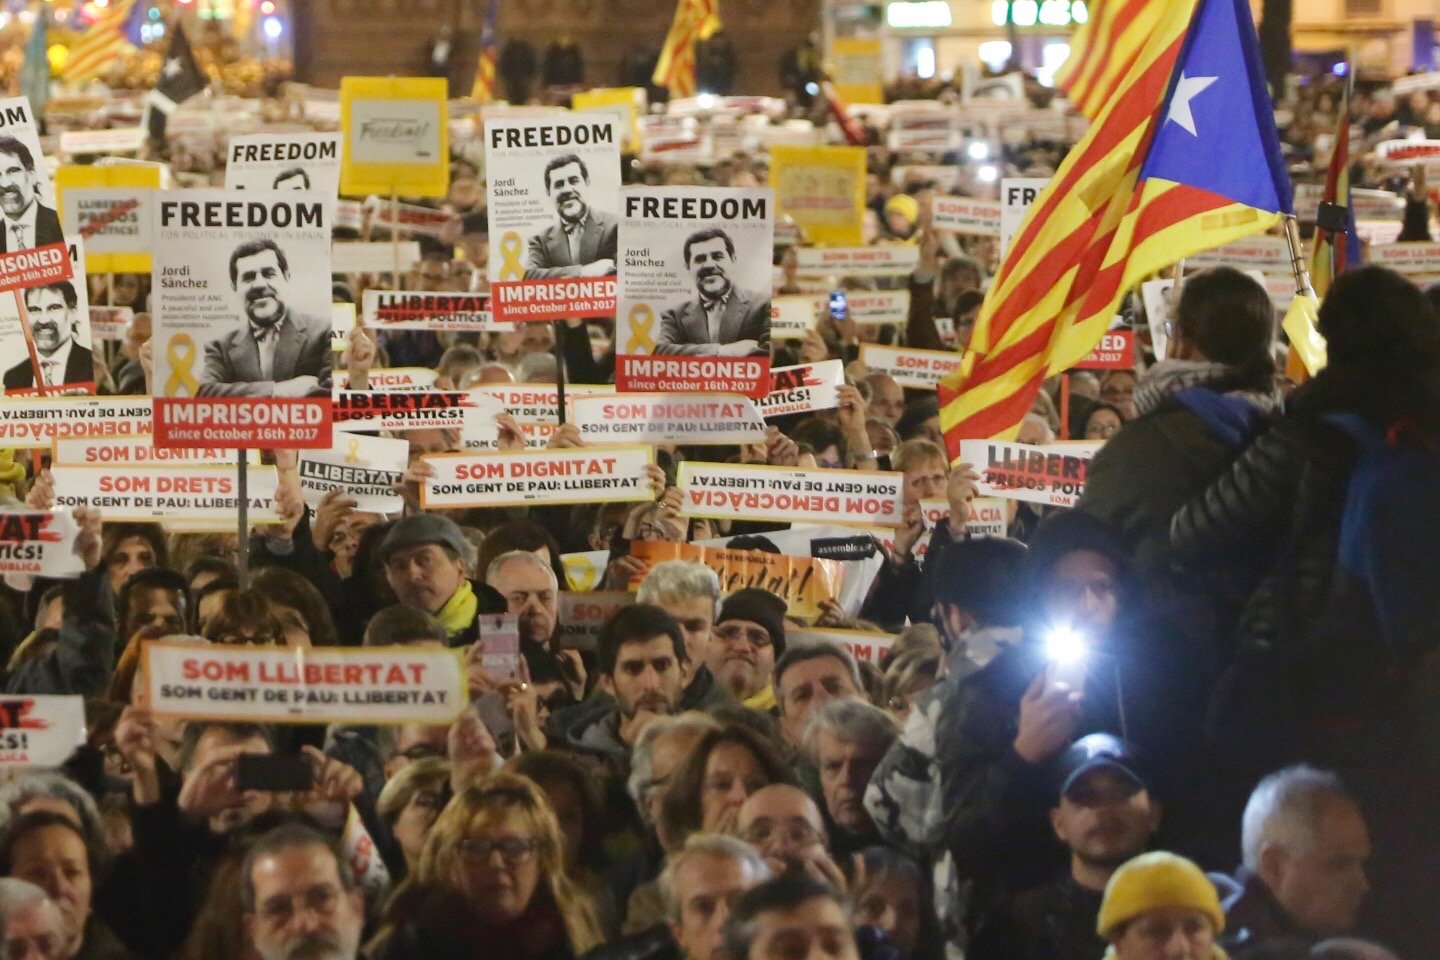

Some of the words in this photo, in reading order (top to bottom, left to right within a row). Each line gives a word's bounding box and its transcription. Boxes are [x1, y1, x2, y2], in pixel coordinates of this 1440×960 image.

[491, 123, 613, 149] FREEDOM
[232, 141, 337, 162] FREEDOM
[493, 177, 515, 187] Jordi
[161, 201, 323, 227] FREEDOM
[625, 197, 766, 220] FREEDOM
[625, 248, 650, 258] Jordi
[42, 266, 63, 279] 2017
[161, 265, 190, 276] Jordi
[499, 281, 617, 303] IMPRISONED
[378, 294, 490, 311] LLIBERTAT
[503, 305, 529, 315] since
[529, 302, 566, 314] October
[569, 301, 591, 311] 16th
[592, 299, 616, 311] 2017
[624, 360, 761, 380] IMPRISONED
[896, 355, 929, 369] SOM
[628, 380, 656, 390] since
[658, 380, 701, 391] October
[703, 381, 729, 391] 16th
[730, 381, 757, 392] 2017
[163, 403, 324, 425] IMPRISONED
[602, 404, 648, 420] SOM
[651, 403, 745, 419] DIGNITAT
[168, 429, 201, 440] since
[203, 428, 253, 440] October
[256, 428, 286, 440] 16th
[288, 428, 318, 440] 2017
[581, 423, 609, 433] SOM
[611, 422, 645, 433] GENT
[85, 446, 130, 462] SOM
[303, 461, 401, 485] LLIBERTAT
[455, 463, 508, 481] SOM
[510, 458, 617, 479] DIGNITAT
[99, 476, 151, 493] SOM
[157, 475, 233, 494] DRETS
[432, 483, 463, 495] SOM
[466, 482, 504, 493] GENT
[507, 481, 525, 492] DE
[527, 480, 561, 491] PAU:
[563, 477, 639, 489] LLIBERTAT
[691, 476, 766, 489] LLIBERTAT
[56, 496, 88, 506] SOM
[92, 496, 131, 507] GENT
[134, 497, 153, 507] DE
[845, 497, 895, 515] SOM
[182, 658, 250, 683] SOM
[259, 661, 428, 686] LLIBERTAT
[160, 685, 202, 699] SOM
[207, 685, 258, 701] GENT
[263, 688, 288, 703] DE
[343, 690, 449, 706] LLIBERTAT
